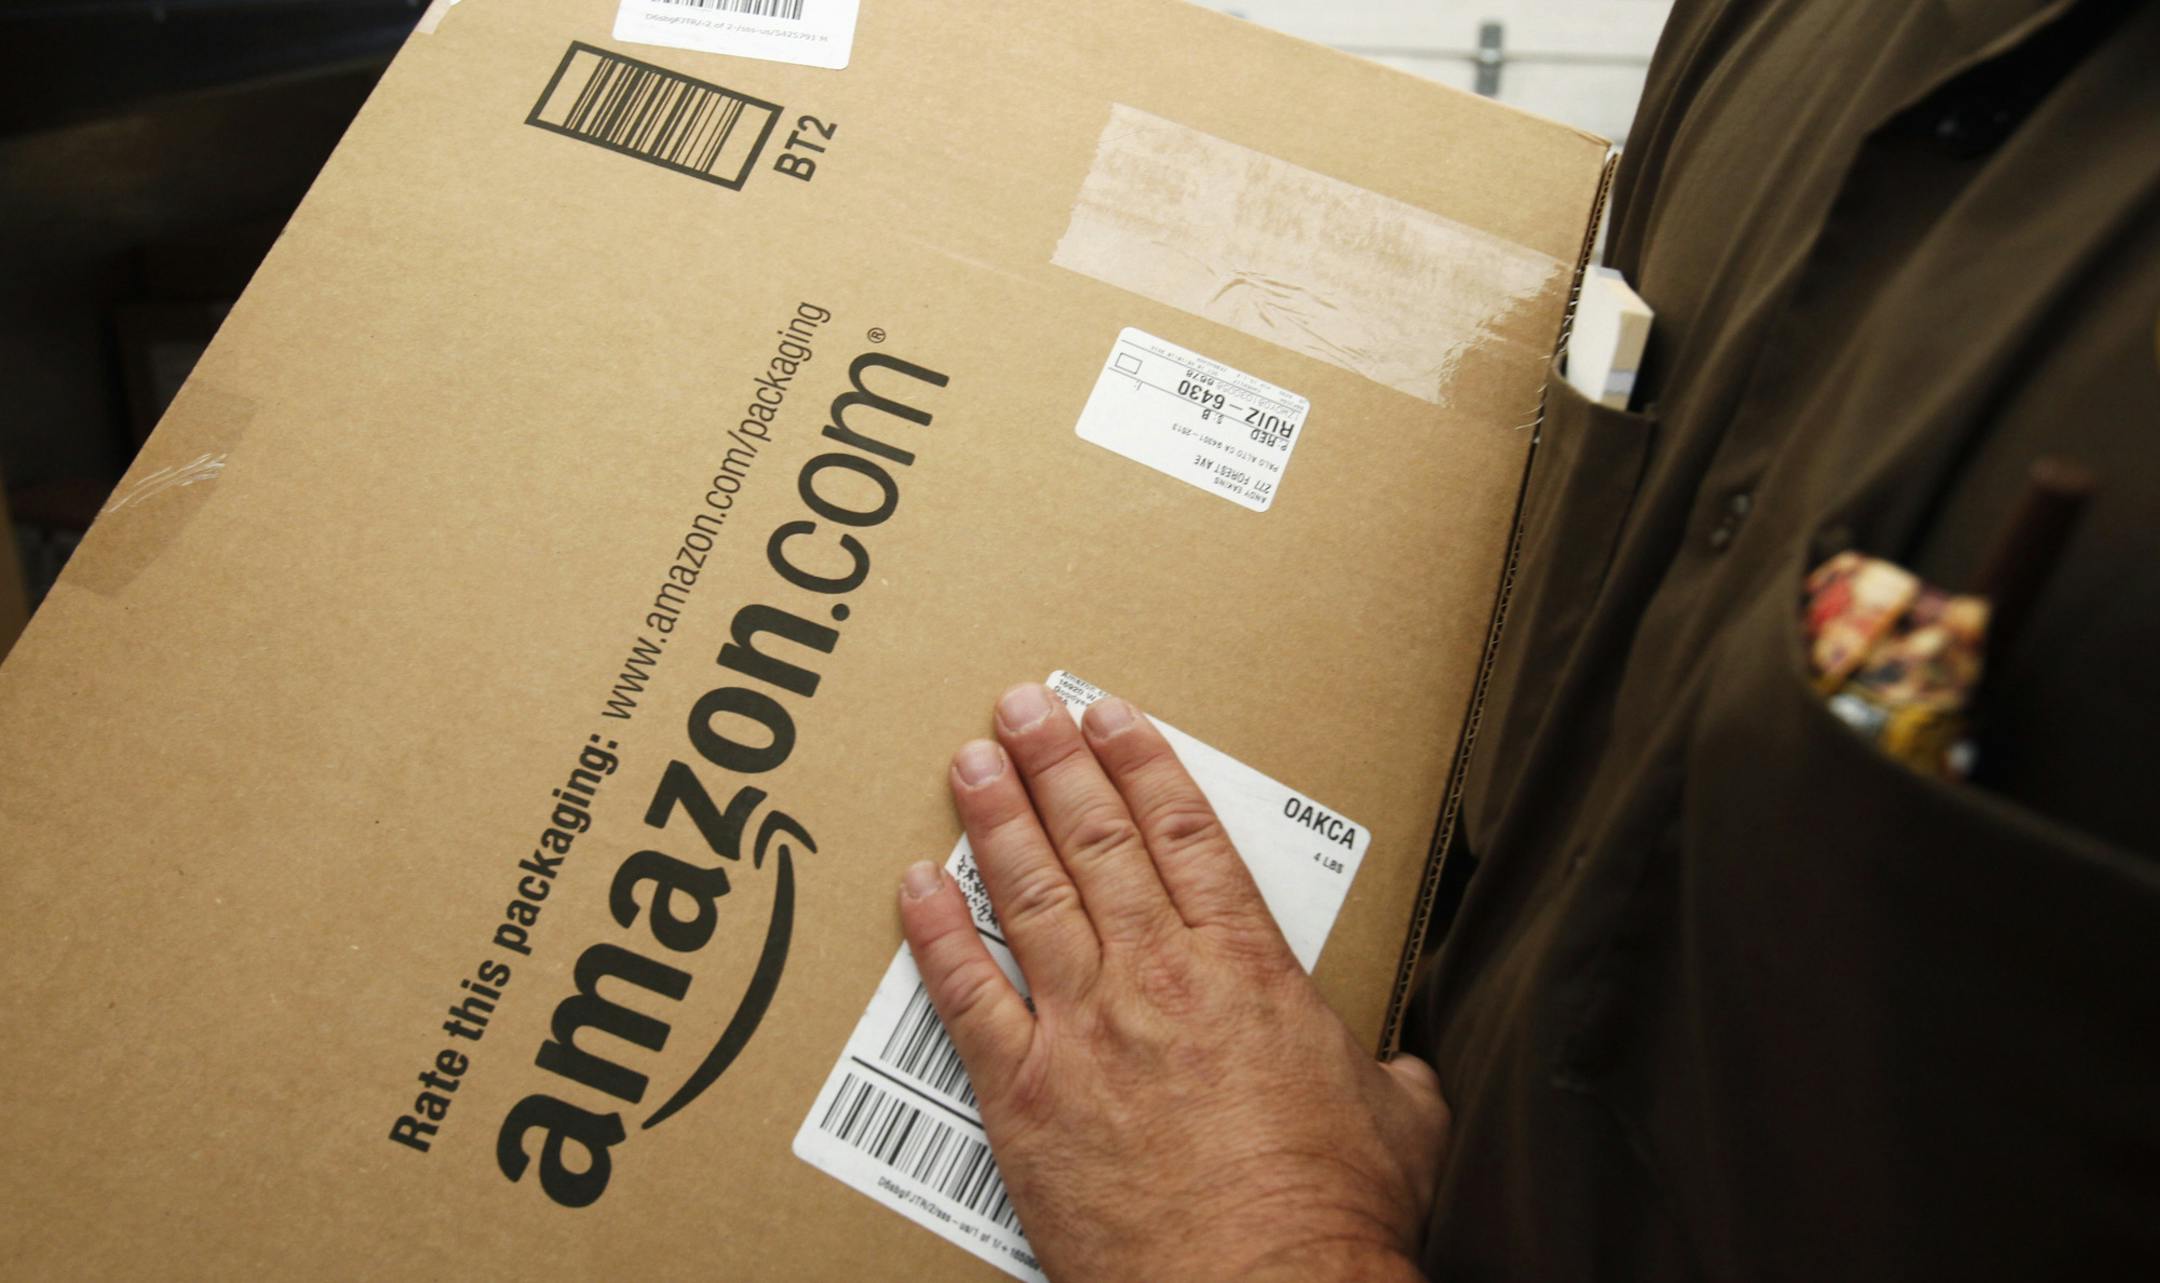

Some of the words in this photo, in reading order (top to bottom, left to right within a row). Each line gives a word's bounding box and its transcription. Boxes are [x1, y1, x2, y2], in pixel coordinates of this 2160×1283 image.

[773, 115, 837, 182] BT2
[1177, 379, 1226, 410] 6430
[1201, 406, 1213, 421] B
[1244, 407, 1295, 438] RUIZ
[1250, 427, 1278, 448] RED
[1224, 444, 1236, 455] CA
[1235, 449, 1258, 464] ALTO
[1193, 453, 1215, 470] AVE
[1258, 458, 1279, 473] PALO
[1213, 463, 1252, 486] FOREST
[1253, 479, 1272, 495] 277
[387, 1048, 469, 1153] Rate
[441, 959, 511, 1041] this
[492, 733, 619, 956] packaging:
[601, 302, 831, 720] www.amazon.com/packaging
[1284, 797, 1356, 850] OAKCA
[1313, 852, 1322, 863] 4
[1322, 856, 1345, 875] LBS
